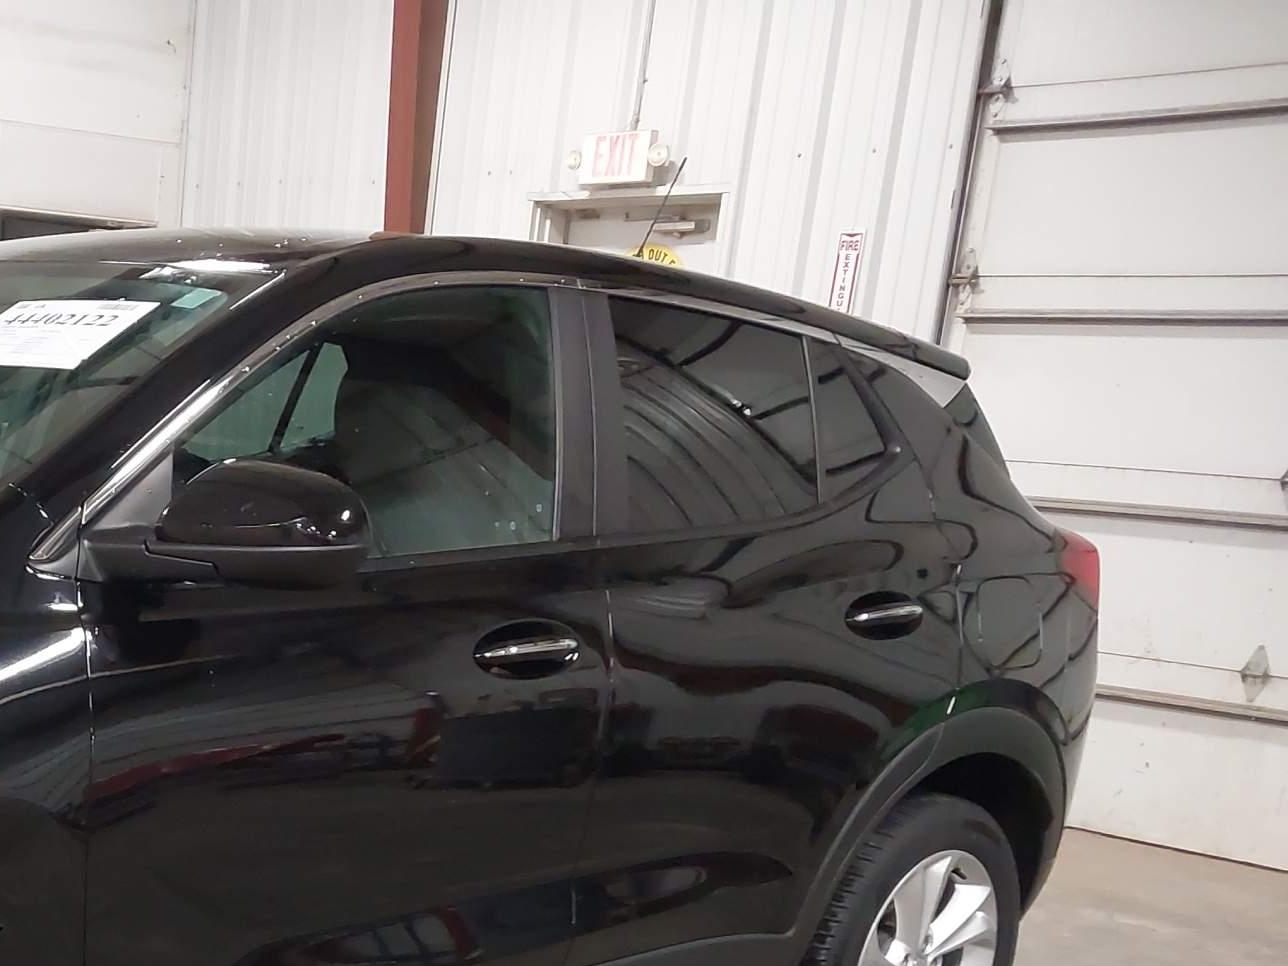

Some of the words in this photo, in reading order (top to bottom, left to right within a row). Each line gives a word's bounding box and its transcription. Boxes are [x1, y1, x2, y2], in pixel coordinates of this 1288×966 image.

[592, 133, 639, 176] EXIT
[840, 240, 860, 251] FIRE
[648, 248, 668, 262] OUT
[836, 253, 852, 310] EXTINGU
[4, 312, 119, 326] 44402122
